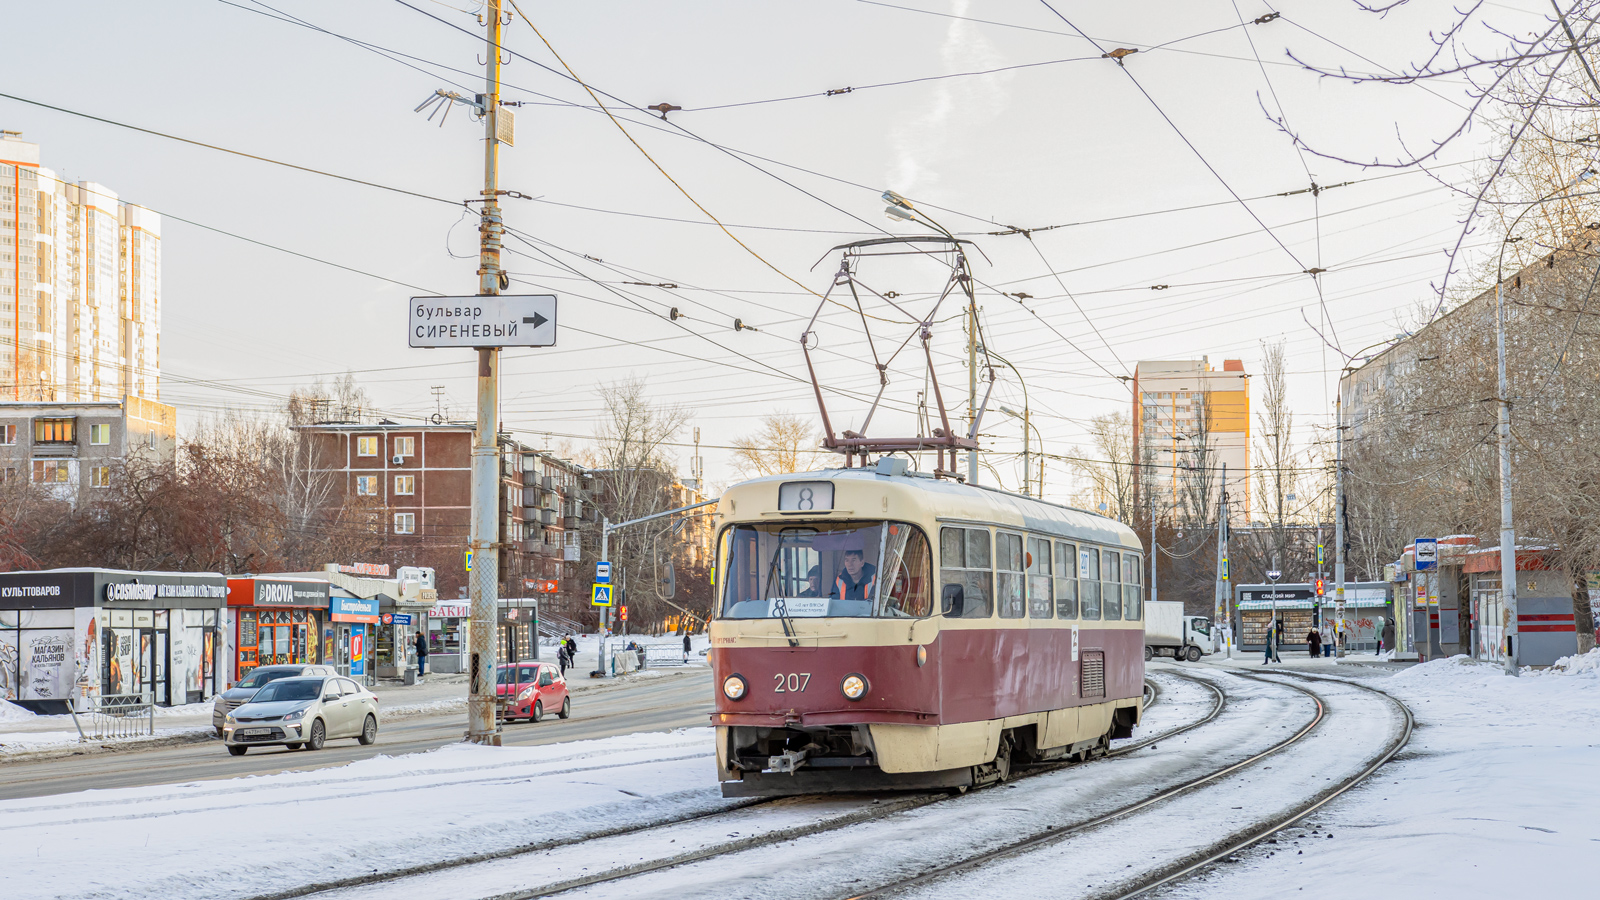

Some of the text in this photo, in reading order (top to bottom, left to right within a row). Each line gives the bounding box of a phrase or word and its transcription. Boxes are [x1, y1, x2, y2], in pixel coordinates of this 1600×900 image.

[416, 305, 482, 320] бульвар
[415, 320, 518, 338] СИРЕНЕВЫЙ
[798, 487, 814, 511] 8
[1, 586, 60, 597] КУЛЬТТОВАРОВ
[265, 583, 294, 602] DROVA
[31, 653, 65, 663] КАЛЬЯНОВ
[34, 645, 64, 655] МАГАЗИН
[774, 673, 812, 693] 207
